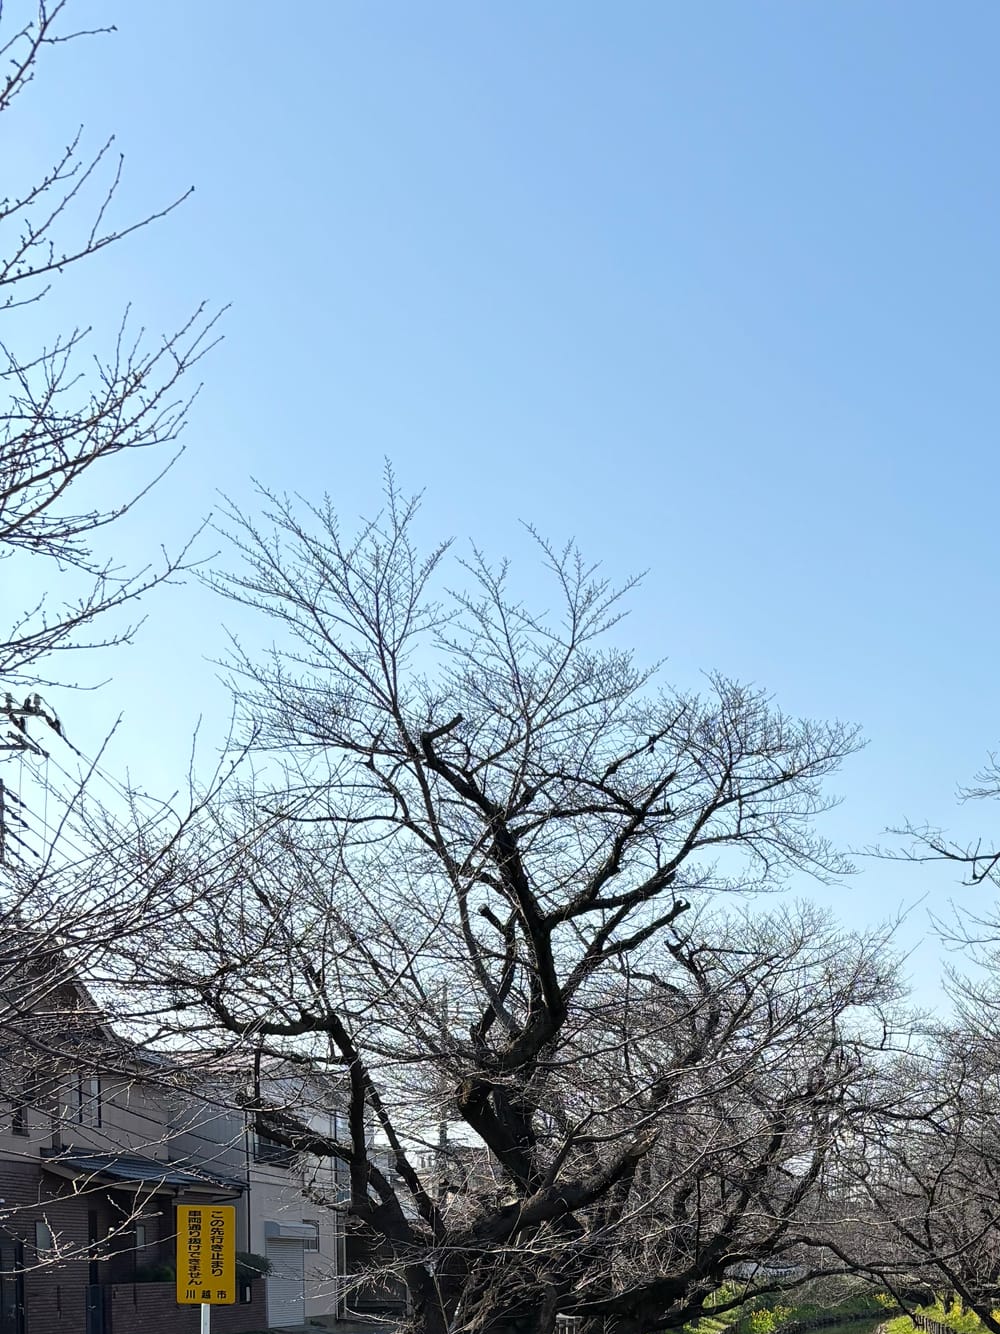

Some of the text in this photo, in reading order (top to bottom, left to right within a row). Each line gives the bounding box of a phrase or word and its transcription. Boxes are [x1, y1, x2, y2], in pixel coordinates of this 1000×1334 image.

[187, 1210, 203, 1286] 車両通り抜けできません
[210, 1211, 225, 1277] この先行き止まり
[185, 1289, 227, 1300] 川越市
